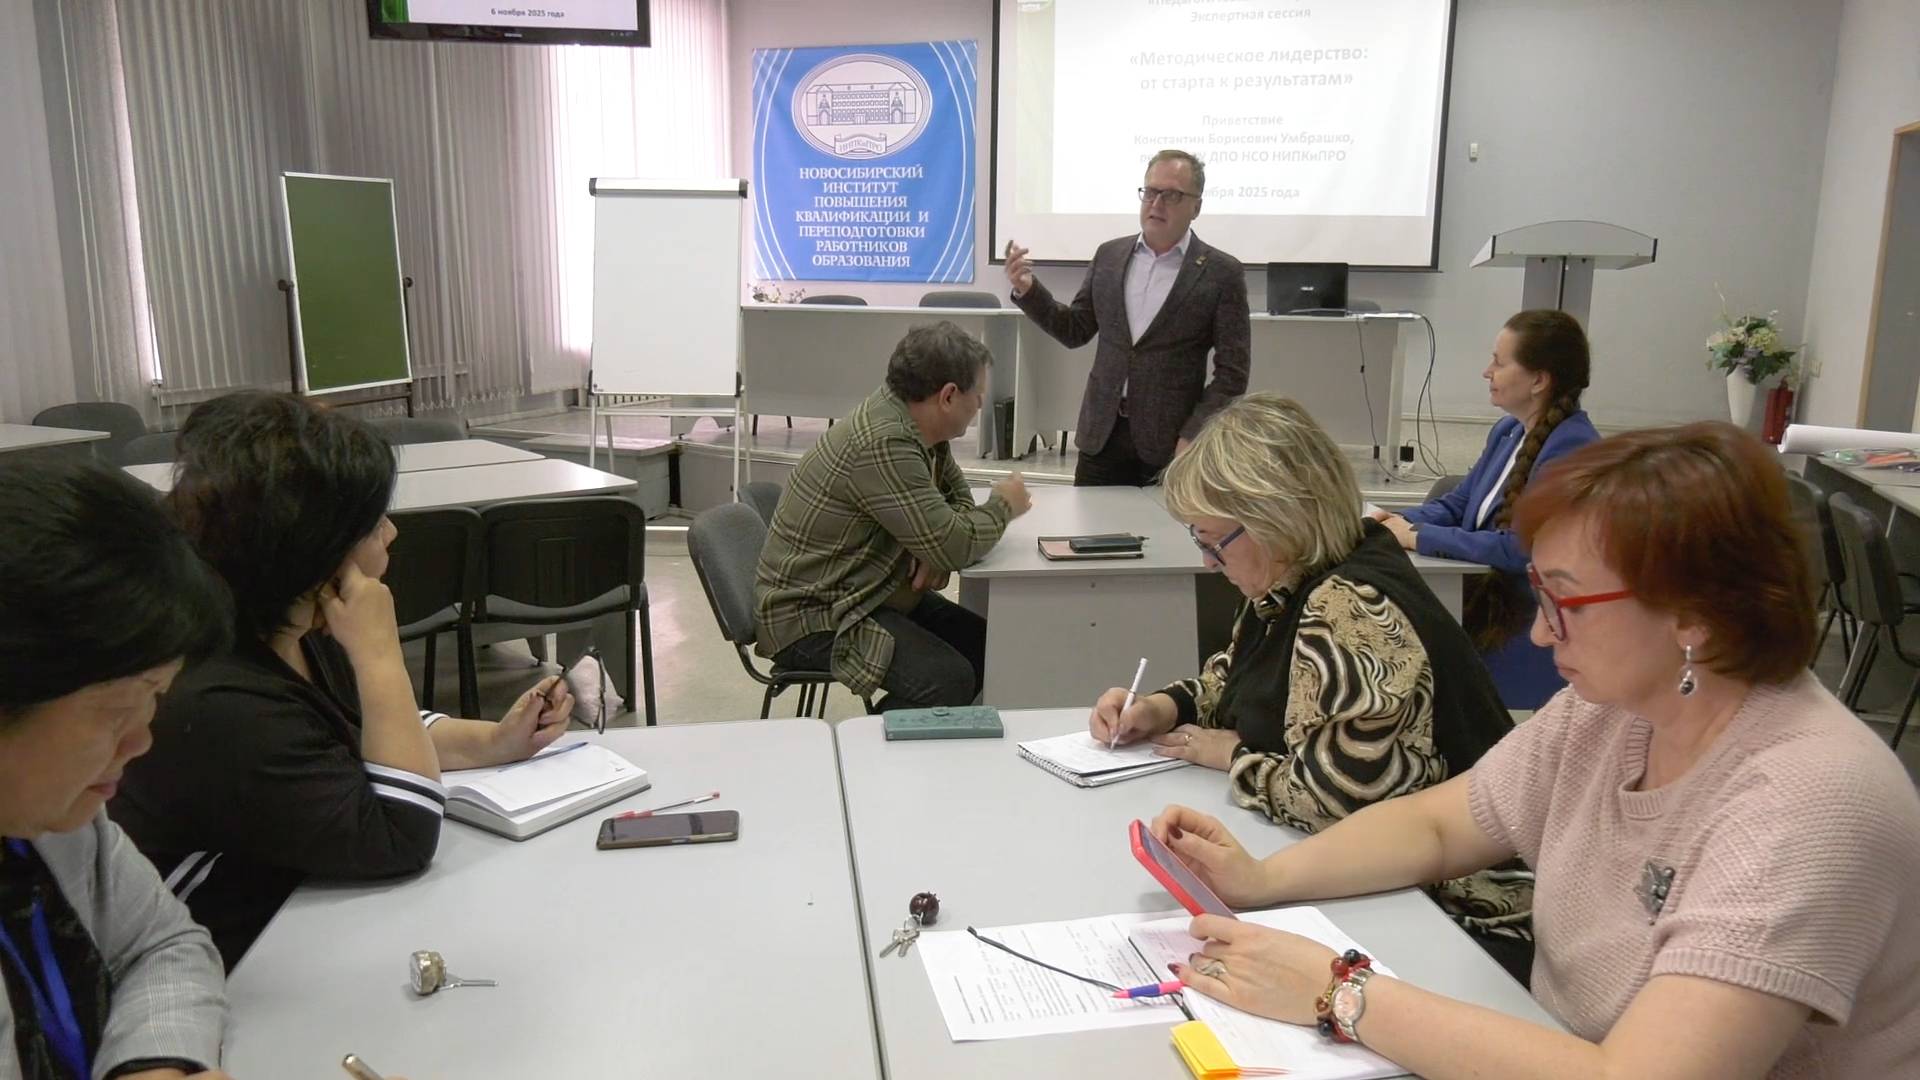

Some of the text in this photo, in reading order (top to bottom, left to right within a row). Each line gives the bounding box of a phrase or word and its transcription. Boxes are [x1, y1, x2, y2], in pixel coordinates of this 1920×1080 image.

[527, 9, 546, 17] 2025
[1190, 7, 1312, 23] Экспертная сессия
[1129, 47, 1369, 69] «Методическое лидерство:
[1140, 72, 1354, 92] от старта к результатам»
[1202, 114, 1284, 128] Приветствие
[1134, 131, 1355, 147] Константин Борисович Умбрашко,
[1209, 151, 1239, 164] ДПО
[1241, 151, 1269, 162] НСО
[1272, 150, 1347, 162] НИПКиПРО
[799, 165, 923, 180] НОВОСИБИРСКИЙ
[822, 181, 899, 194] ИНСТИТУТ
[1203, 186, 1300, 199] ября 2025 года
[814, 195, 908, 208] ПОВЫШЕНИЯ
[795, 211, 929, 225] КВАЛИФИКАЦИИ И
[798, 225, 926, 239] ПЕРЕПОДГОТОВКИ
[815, 240, 908, 253] РАБОТНИКОВ
[811, 254, 911, 268] ОБРАЗОВАНИЯ
